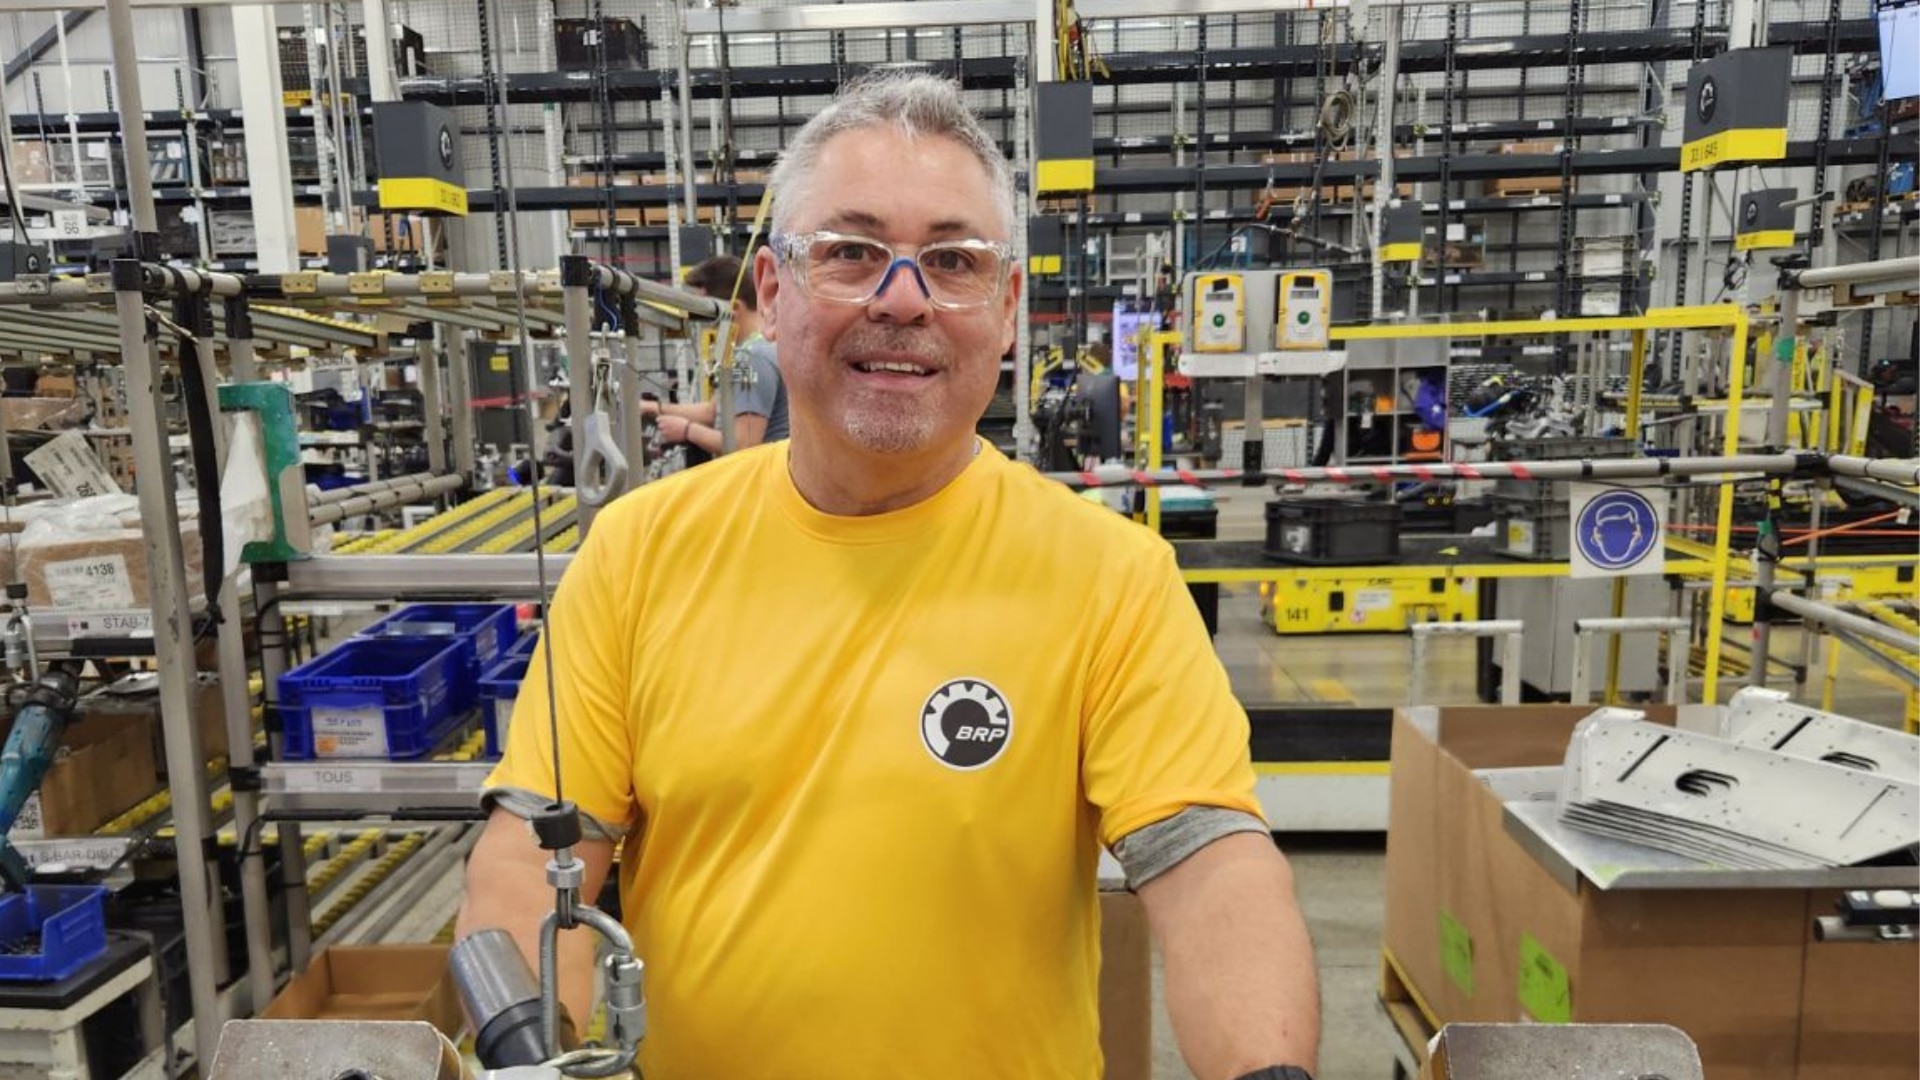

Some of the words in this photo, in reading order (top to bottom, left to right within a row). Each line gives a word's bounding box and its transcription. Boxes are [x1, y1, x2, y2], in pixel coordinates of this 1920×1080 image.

[1286, 608, 1309, 621] 141
[955, 725, 1006, 743] BRP
[314, 770, 354, 784] TOUS
